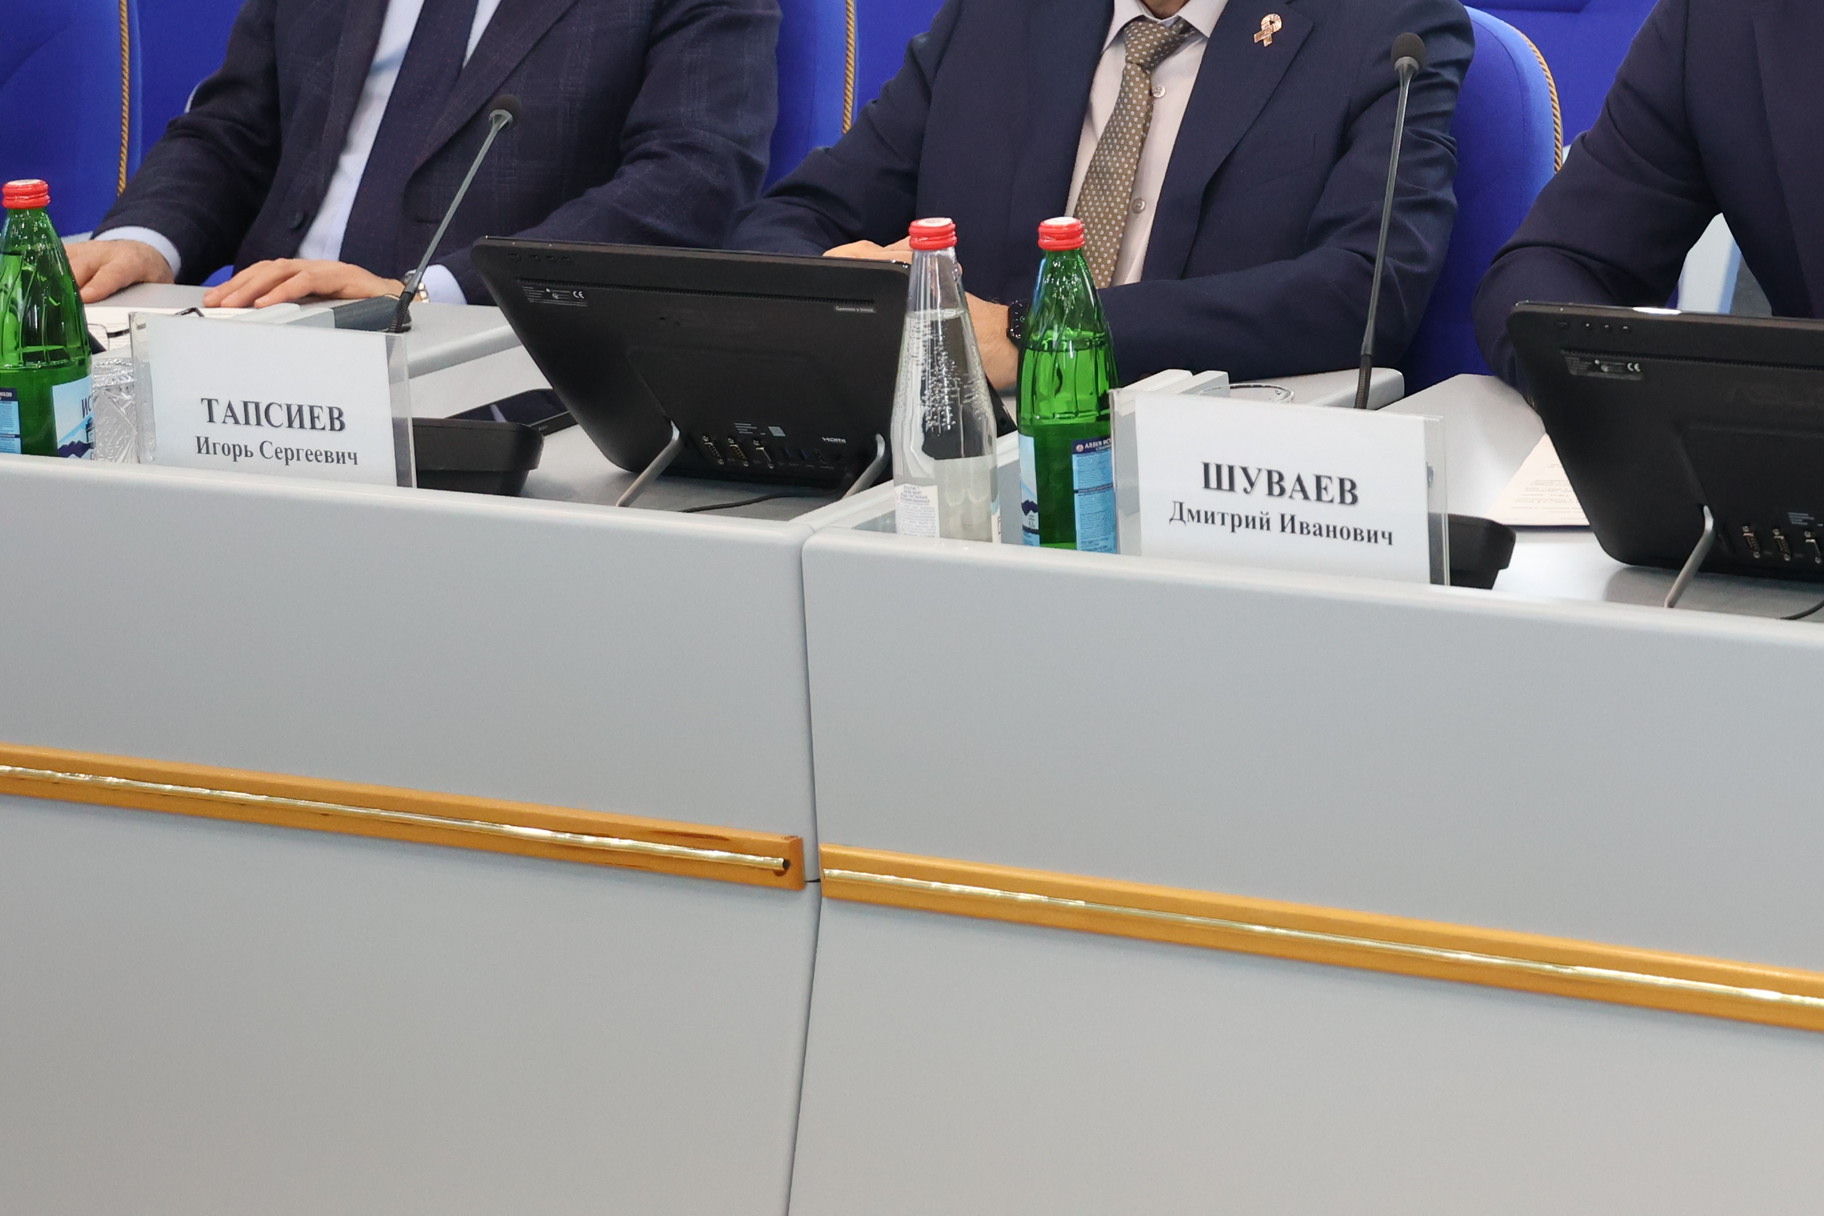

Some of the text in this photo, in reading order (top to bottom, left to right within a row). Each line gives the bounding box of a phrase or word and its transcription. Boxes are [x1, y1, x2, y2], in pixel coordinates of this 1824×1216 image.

[200, 397, 346, 433] ТАПСИЕВ
[194, 435, 359, 467] Игорь Сергеевич
[1201, 461, 1359, 507] ШУВАЕВ
[1168, 500, 1393, 546] Дмитрий Иванович
